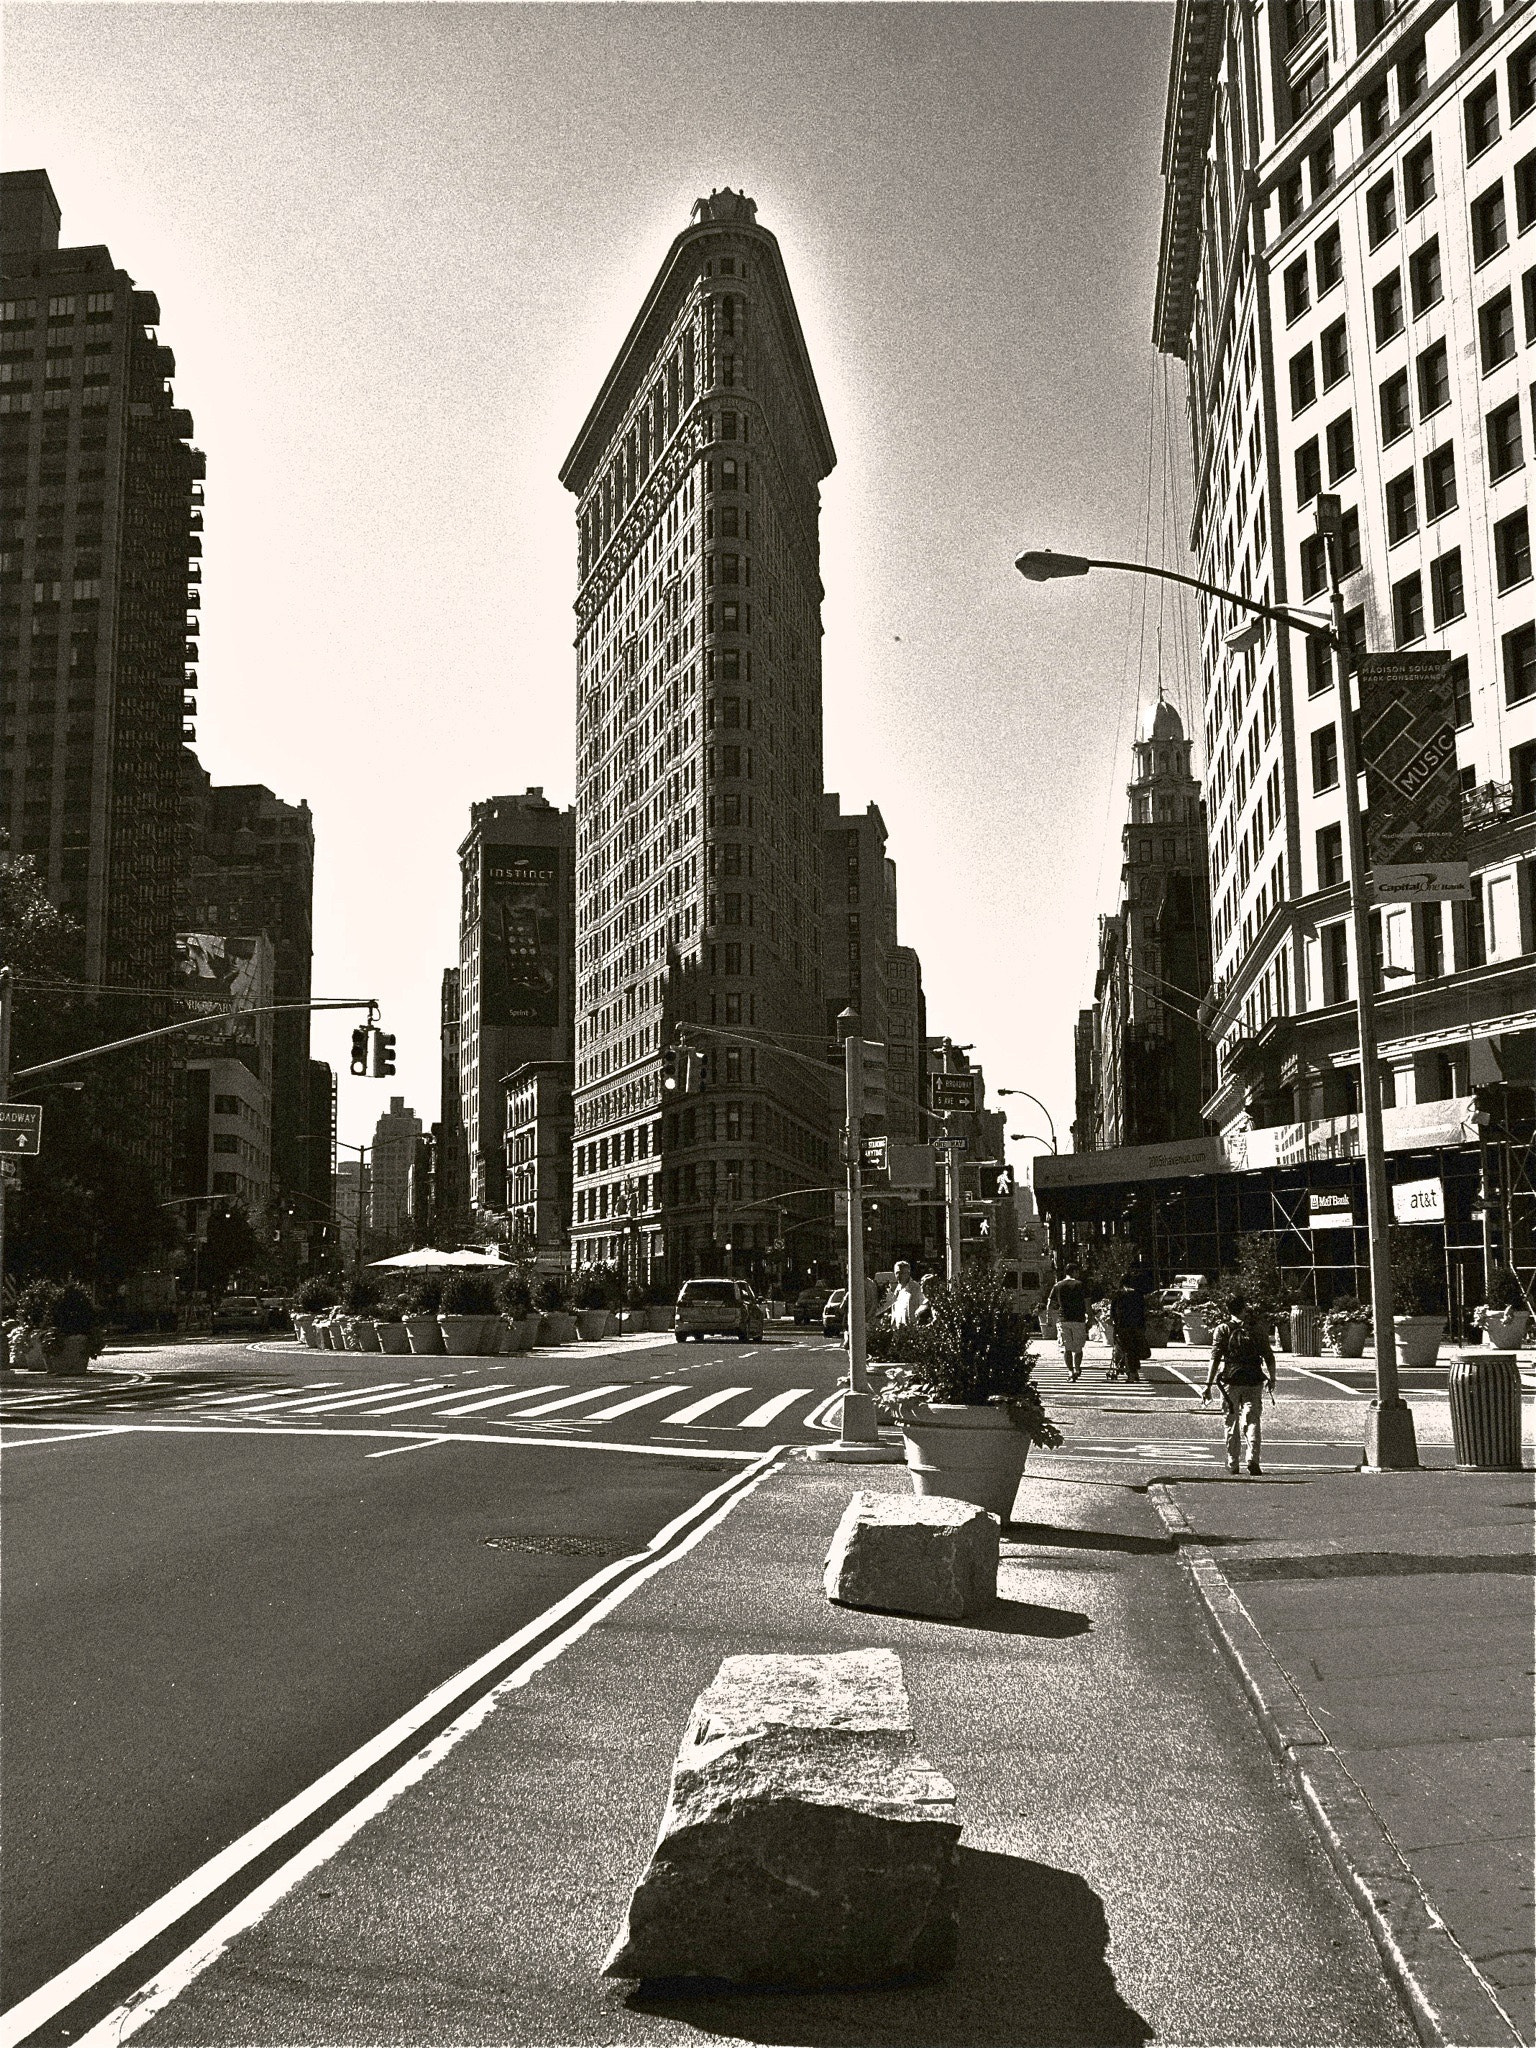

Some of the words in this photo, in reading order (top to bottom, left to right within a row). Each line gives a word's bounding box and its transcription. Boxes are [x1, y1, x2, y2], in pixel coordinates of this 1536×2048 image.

[1362, 665, 1405, 674] MADISON
[1408, 664, 1447, 672] SQUARE
[1386, 673, 1446, 681] CONSERVANCY
[1401, 735, 1453, 791] MUSIC
[1441, 883, 1465, 891] Bank
[509, 1008, 529, 1017] Sprint
[945, 1079, 972, 1089] BROADWAY
[938, 1096, 942, 1104] 5
[944, 1096, 954, 1105] AVE
[1333, 1194, 1349, 1206] Bank
[1411, 1189, 1437, 1208] at&t
